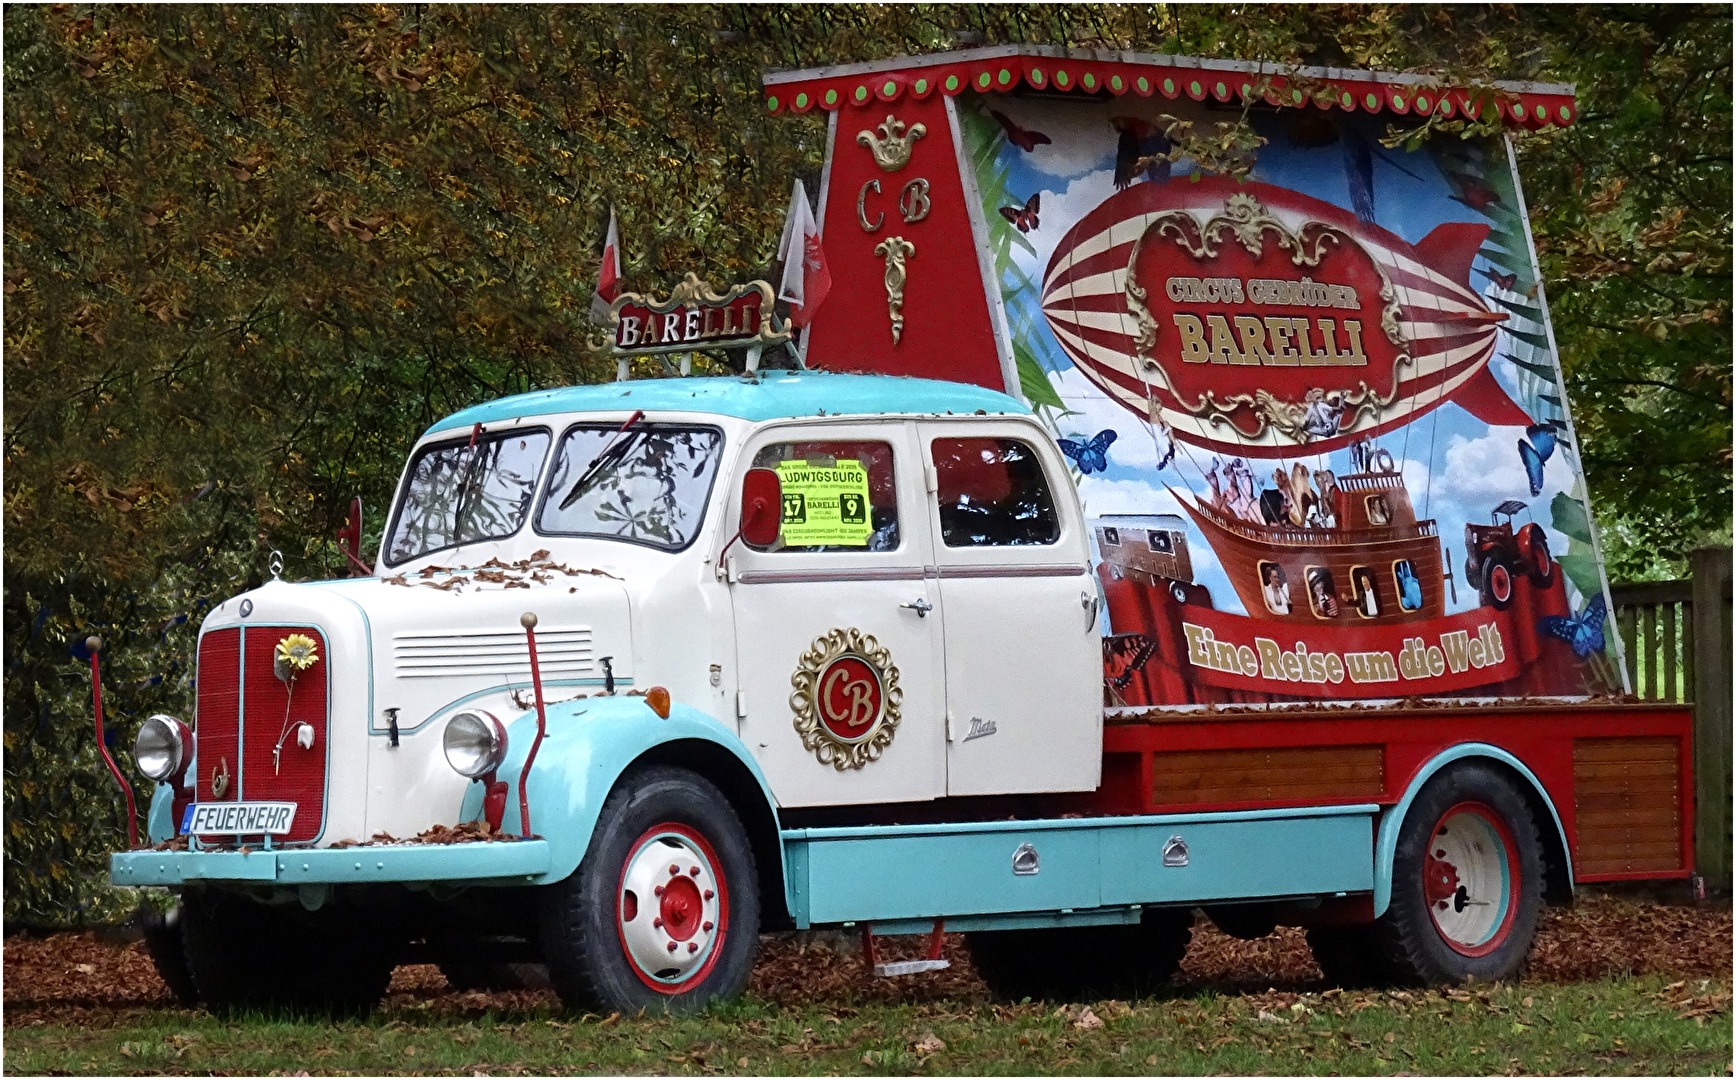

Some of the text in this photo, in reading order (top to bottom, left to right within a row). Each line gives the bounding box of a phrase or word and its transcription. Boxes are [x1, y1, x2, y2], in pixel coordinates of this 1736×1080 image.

[857, 178, 931, 232] C B
[1166, 276, 1361, 310] CIRCUS GEBRÜDER
[619, 304, 753, 346] BARELLI
[1173, 313, 1368, 367] BARELLI
[784, 500, 801, 517] 17
[807, 501, 840, 509] BARELLI
[846, 499, 858, 516] 9
[1183, 621, 1505, 684] Eine Reise um die Welt
[823, 668, 874, 727] CB
[193, 806, 291, 830] FEUERWEHR
